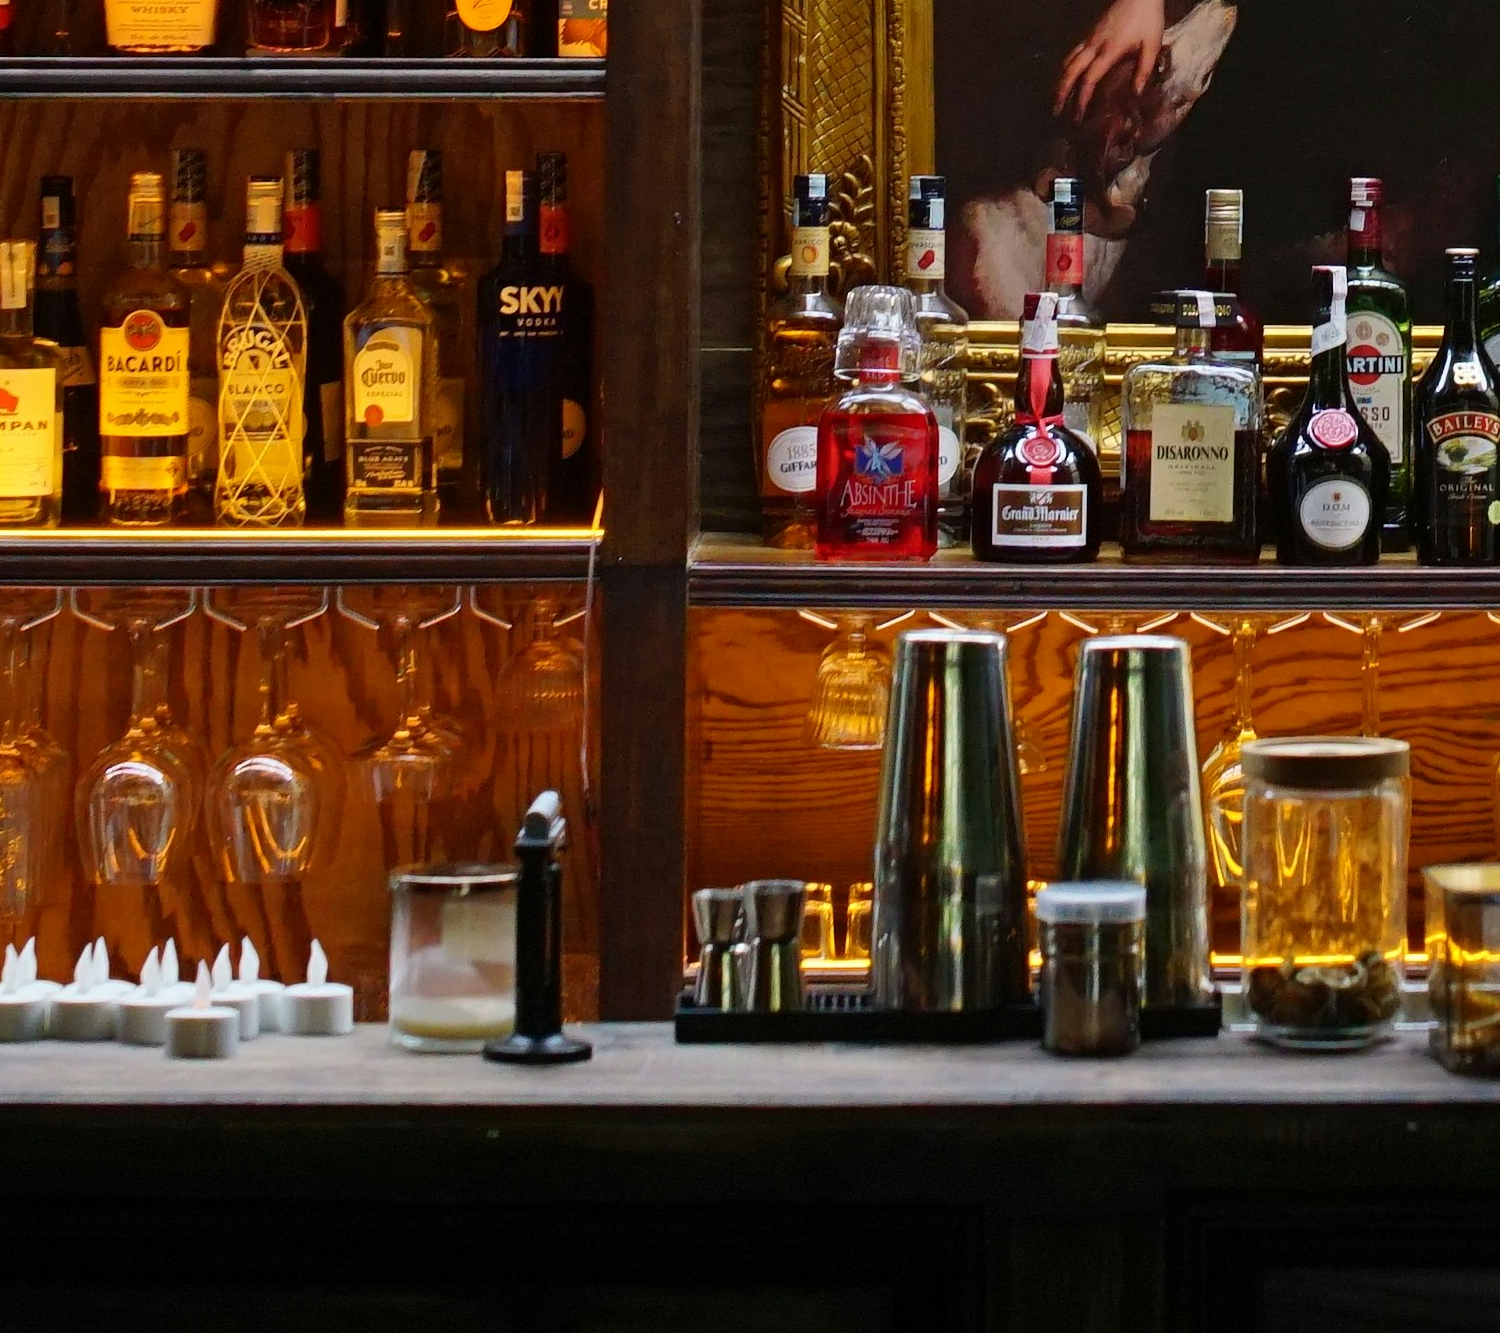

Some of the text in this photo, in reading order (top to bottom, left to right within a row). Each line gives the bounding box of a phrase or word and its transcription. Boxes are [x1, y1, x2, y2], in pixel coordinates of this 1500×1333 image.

[499, 285, 565, 316] SKYY
[516, 318, 557, 328] VODKA
[222, 327, 293, 371] BRUGAL
[107, 350, 183, 373] BACARDÍ
[1347, 356, 1402, 373] RTINI
[361, 369, 407, 388] Cuervo
[228, 383, 285, 395] BLANCO
[1431, 414, 1500, 438] BAILEYS
[786, 443, 817, 461] 1885
[780, 460, 817, 474] GIFFAR
[840, 479, 918, 510] ABSINTHE
[1438, 482, 1495, 493] ORIGINAL
